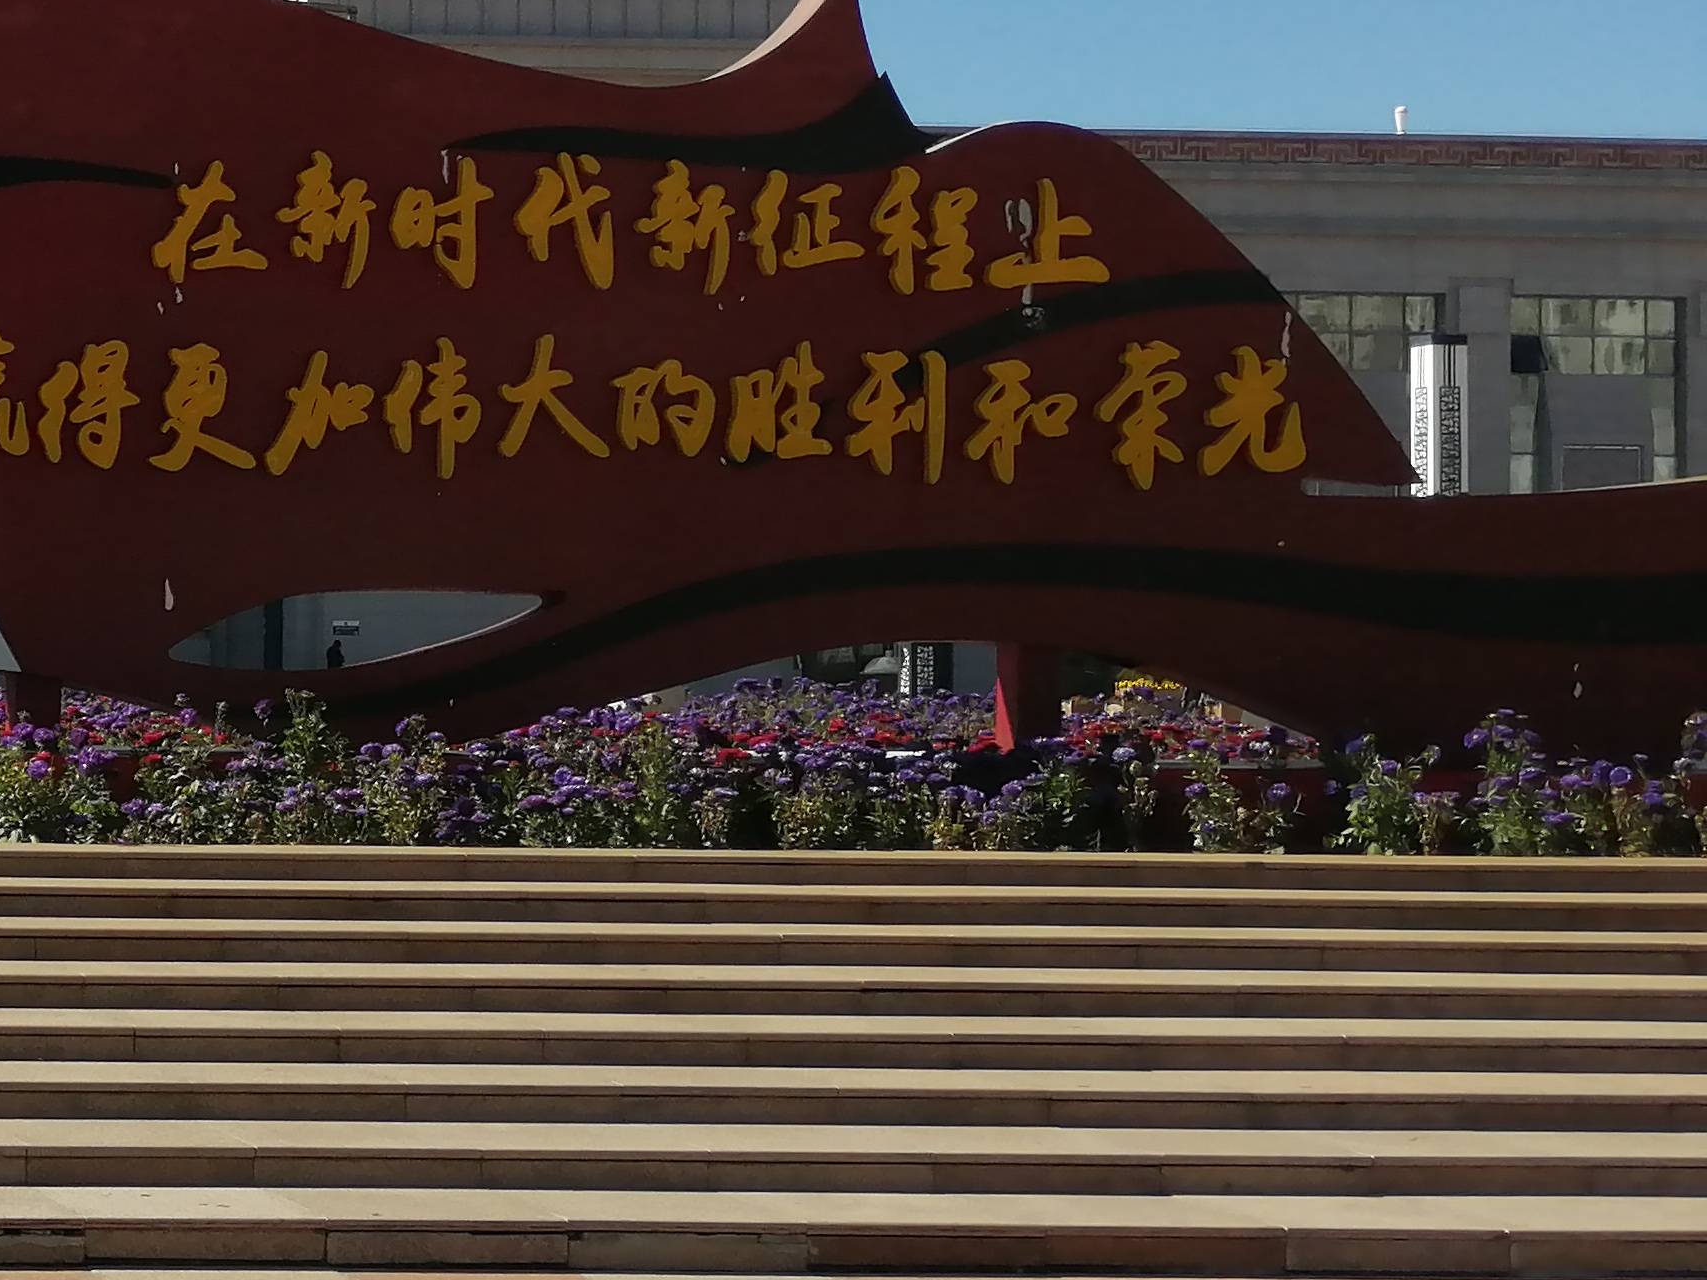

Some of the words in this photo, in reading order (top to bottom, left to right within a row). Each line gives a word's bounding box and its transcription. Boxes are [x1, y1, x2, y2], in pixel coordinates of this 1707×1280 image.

[151, 150, 1110, 296] 在新时代新征程上
